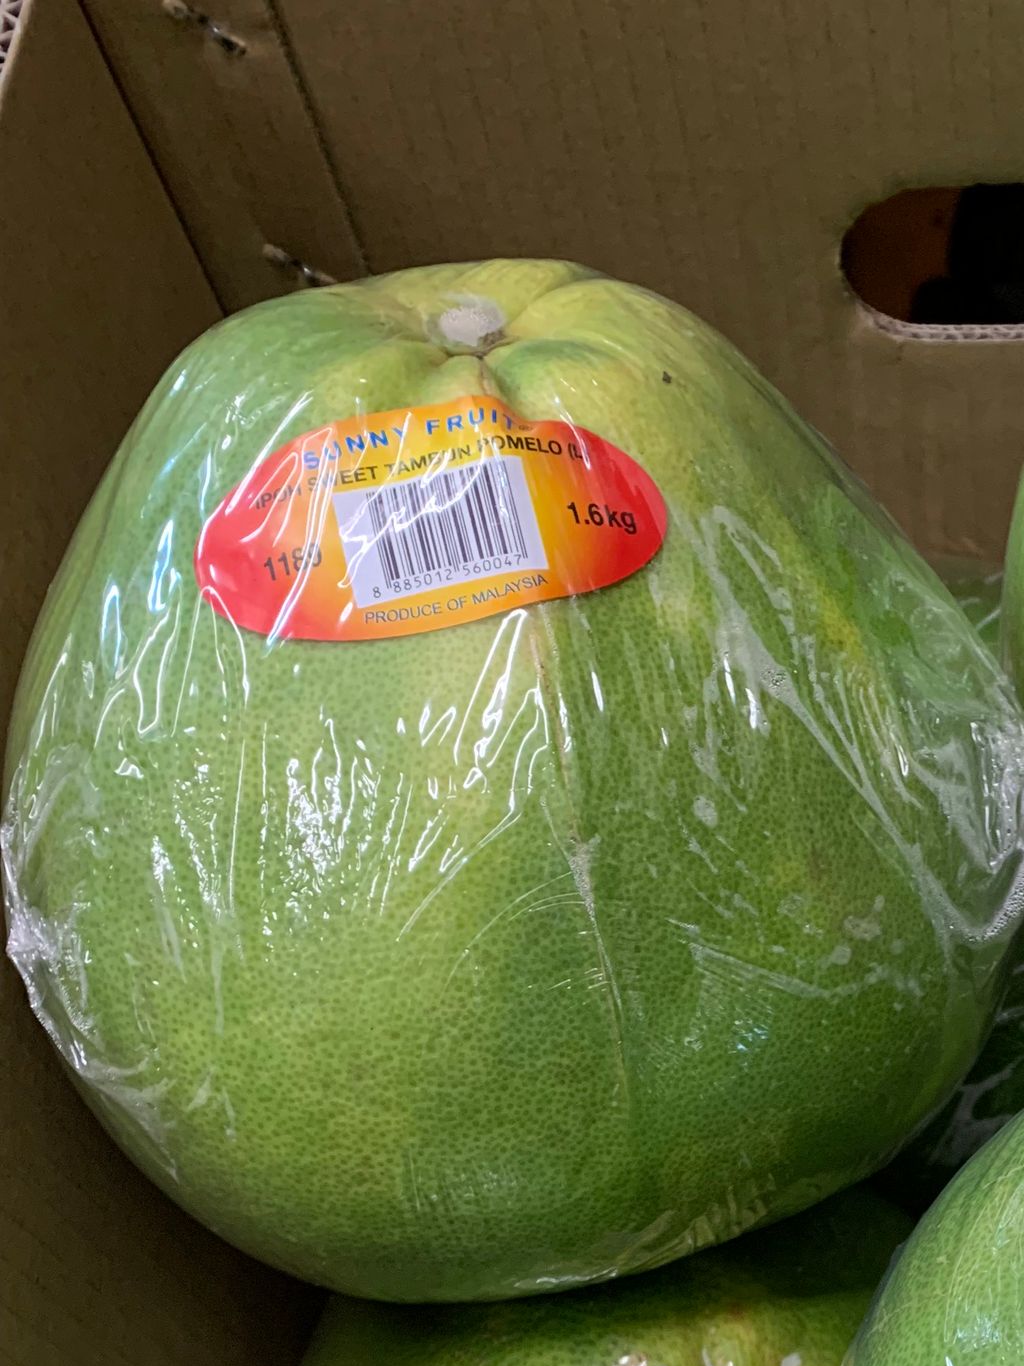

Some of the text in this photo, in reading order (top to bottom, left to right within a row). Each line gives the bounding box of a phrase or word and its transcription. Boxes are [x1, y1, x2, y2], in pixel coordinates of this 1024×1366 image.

[255, 483, 302, 510] IPOH
[476, 434, 563, 456] POMELO
[567, 501, 638, 535] 1.6kg
[364, 572, 549, 625] PRODUCE OF MALAYSIA
[372, 554, 524, 599] 8 885012 560047
